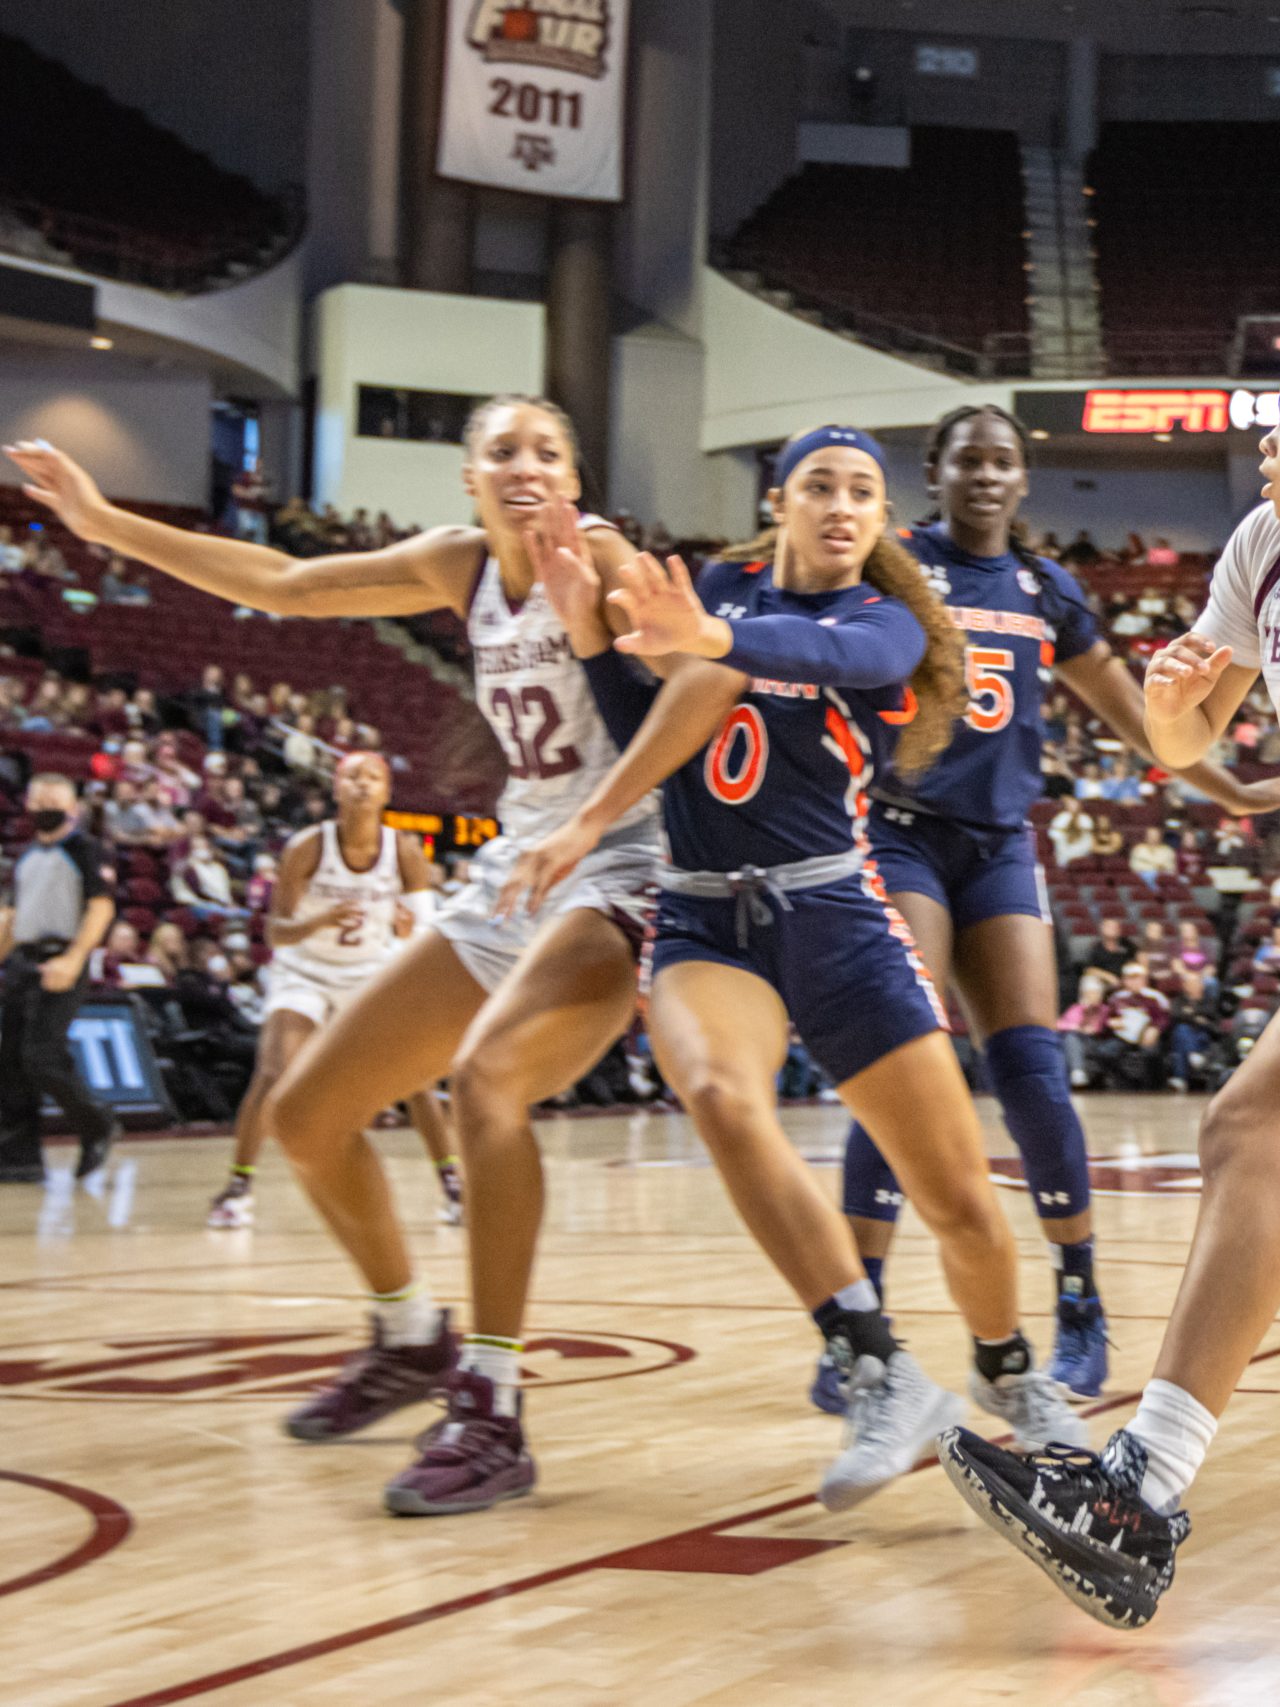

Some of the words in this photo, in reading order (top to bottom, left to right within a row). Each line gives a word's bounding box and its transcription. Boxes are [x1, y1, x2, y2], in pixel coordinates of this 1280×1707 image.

[489, 77, 582, 129] 2011
[1083, 389, 1229, 433] ESPN
[704, 703, 769, 805] 0
